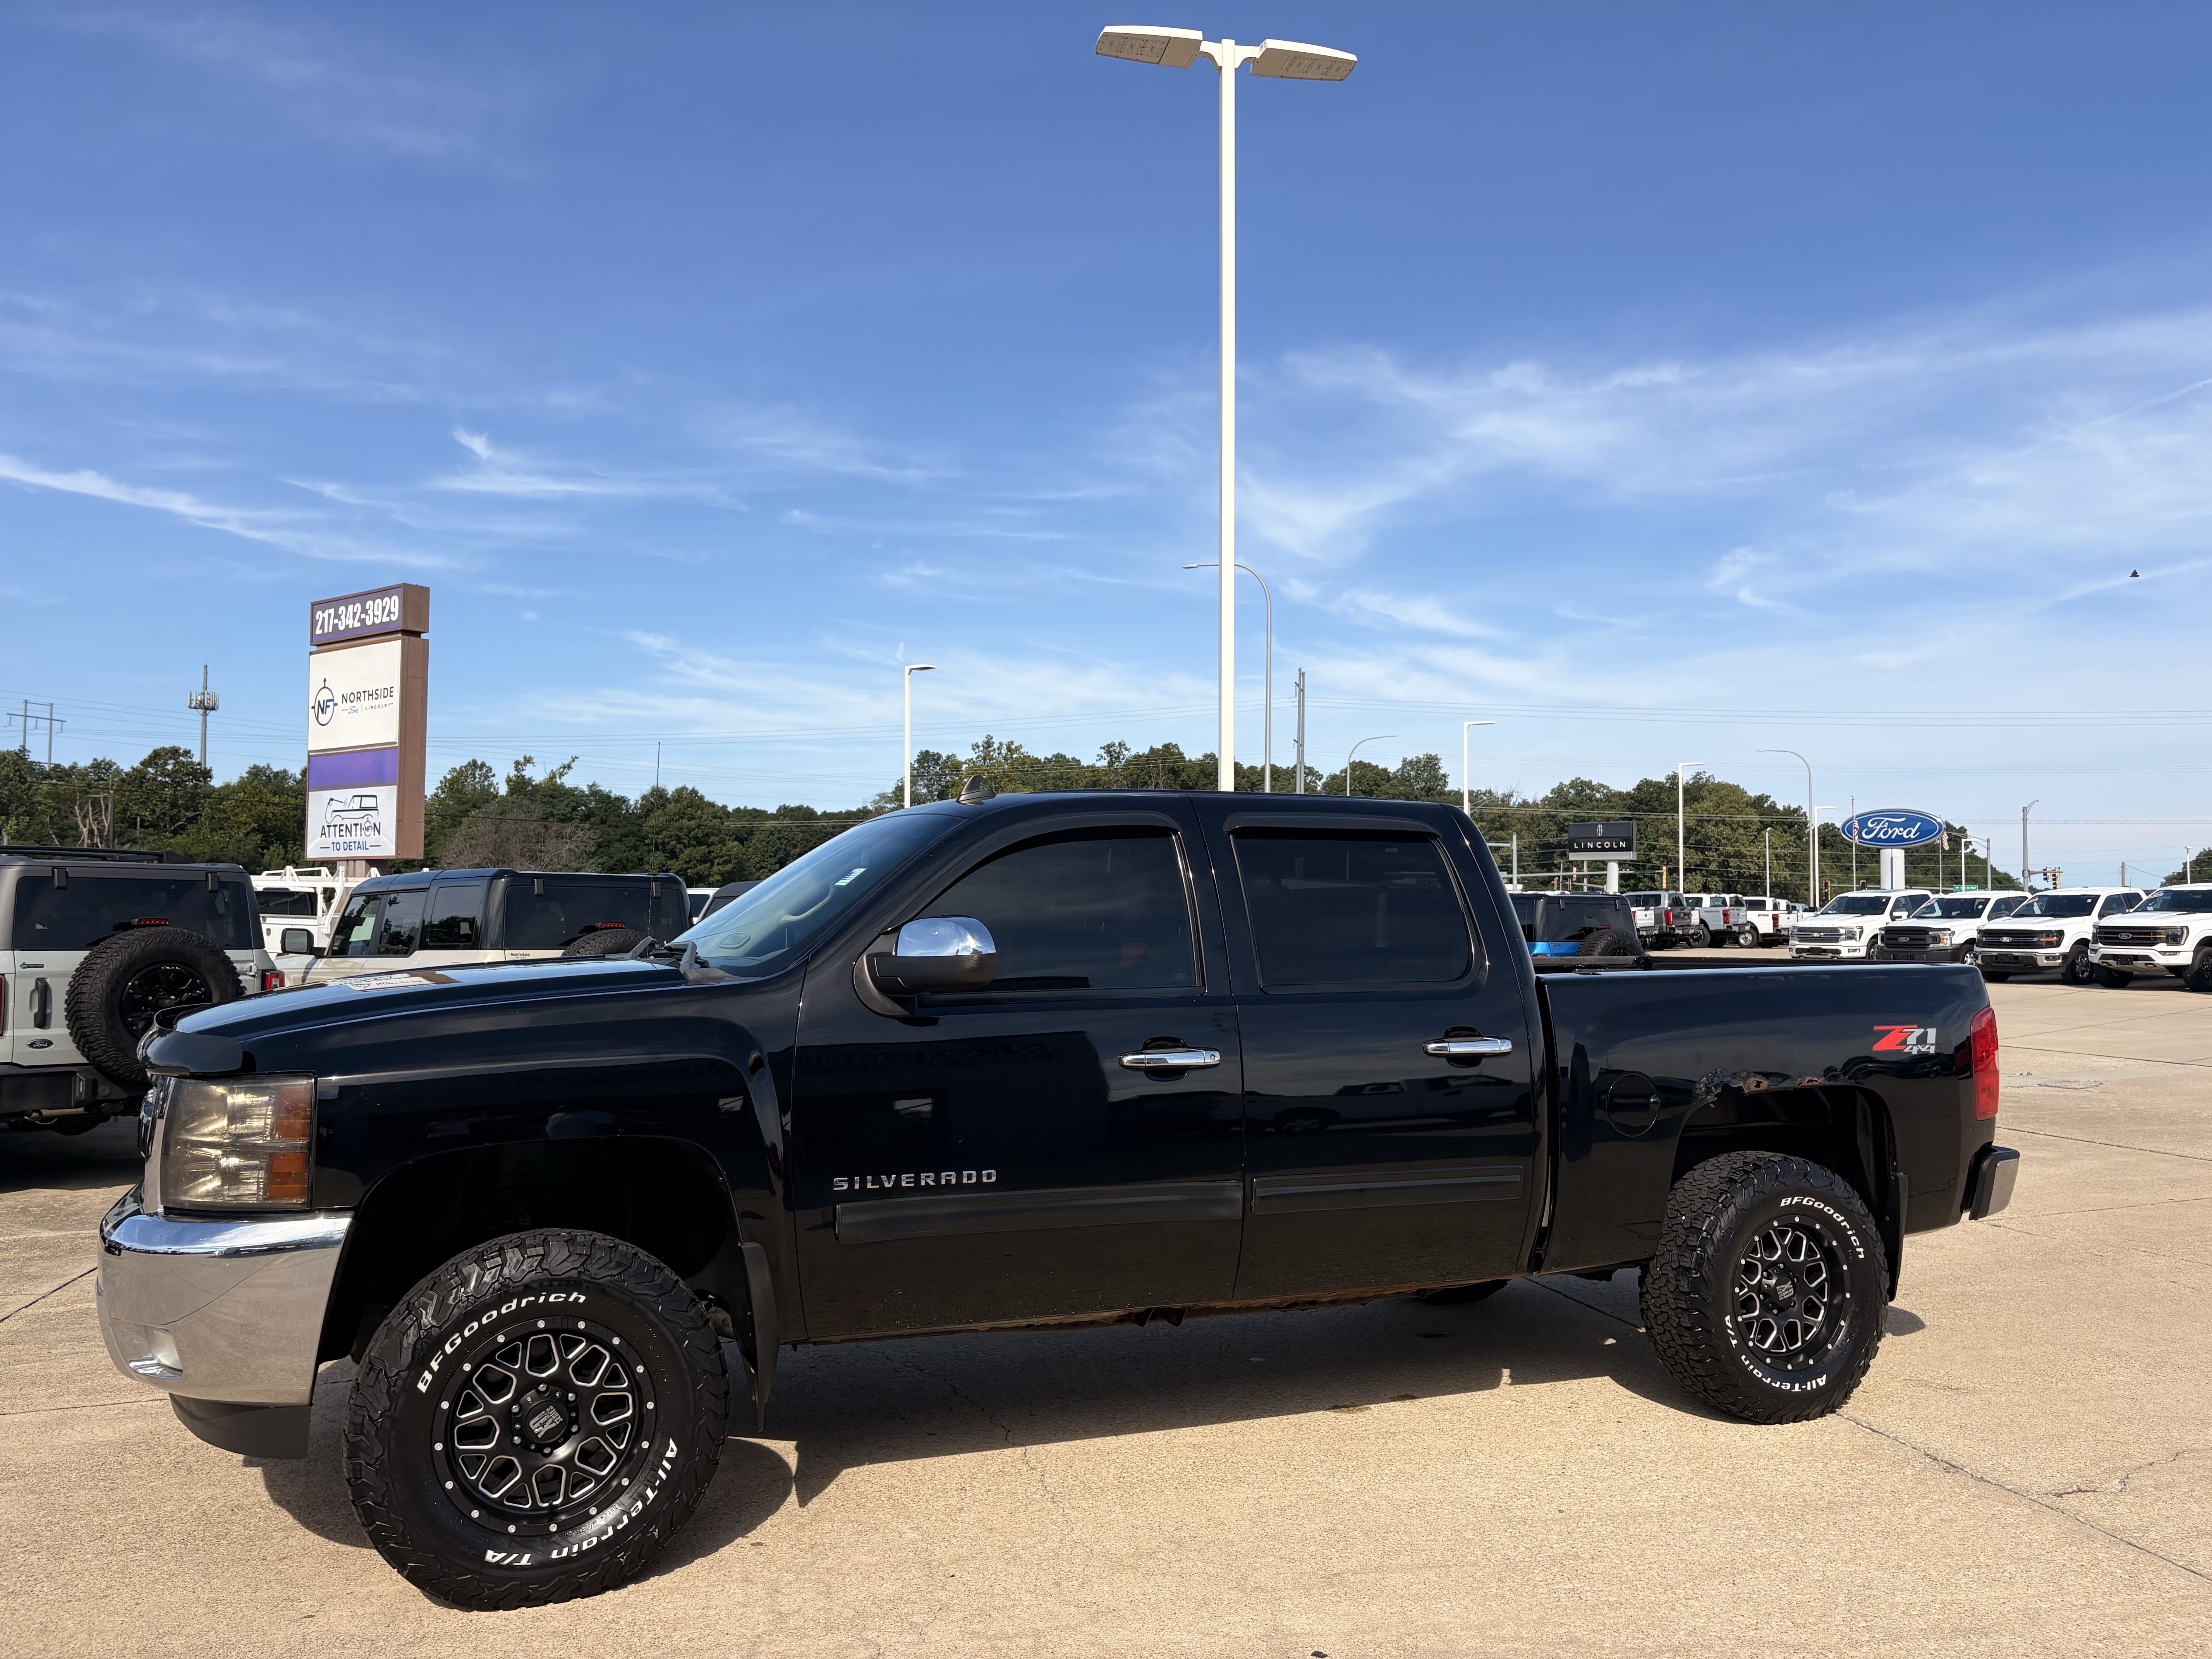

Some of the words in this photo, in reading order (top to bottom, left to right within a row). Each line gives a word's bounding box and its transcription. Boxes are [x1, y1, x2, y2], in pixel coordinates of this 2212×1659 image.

[315, 595, 399, 635] 217-342-3929
[342, 686, 394, 704] NORTHSIDE
[1862, 817, 1922, 839] Ford
[331, 842, 341, 851] TO
[343, 841, 369, 851] DETAIL
[1872, 1025, 1936, 1051] Z71
[833, 1170, 997, 1190] SILVERADO
[1780, 1196, 1864, 1259] BFGoodrich
[416, 1291, 587, 1393] BFGoodrich
[1724, 1314, 1738, 1348] T/A
[1741, 1355, 1827, 1392] All-Terrain
[550, 1437, 678, 1559] All-Terrain
[484, 1549, 532, 1566] T/A
